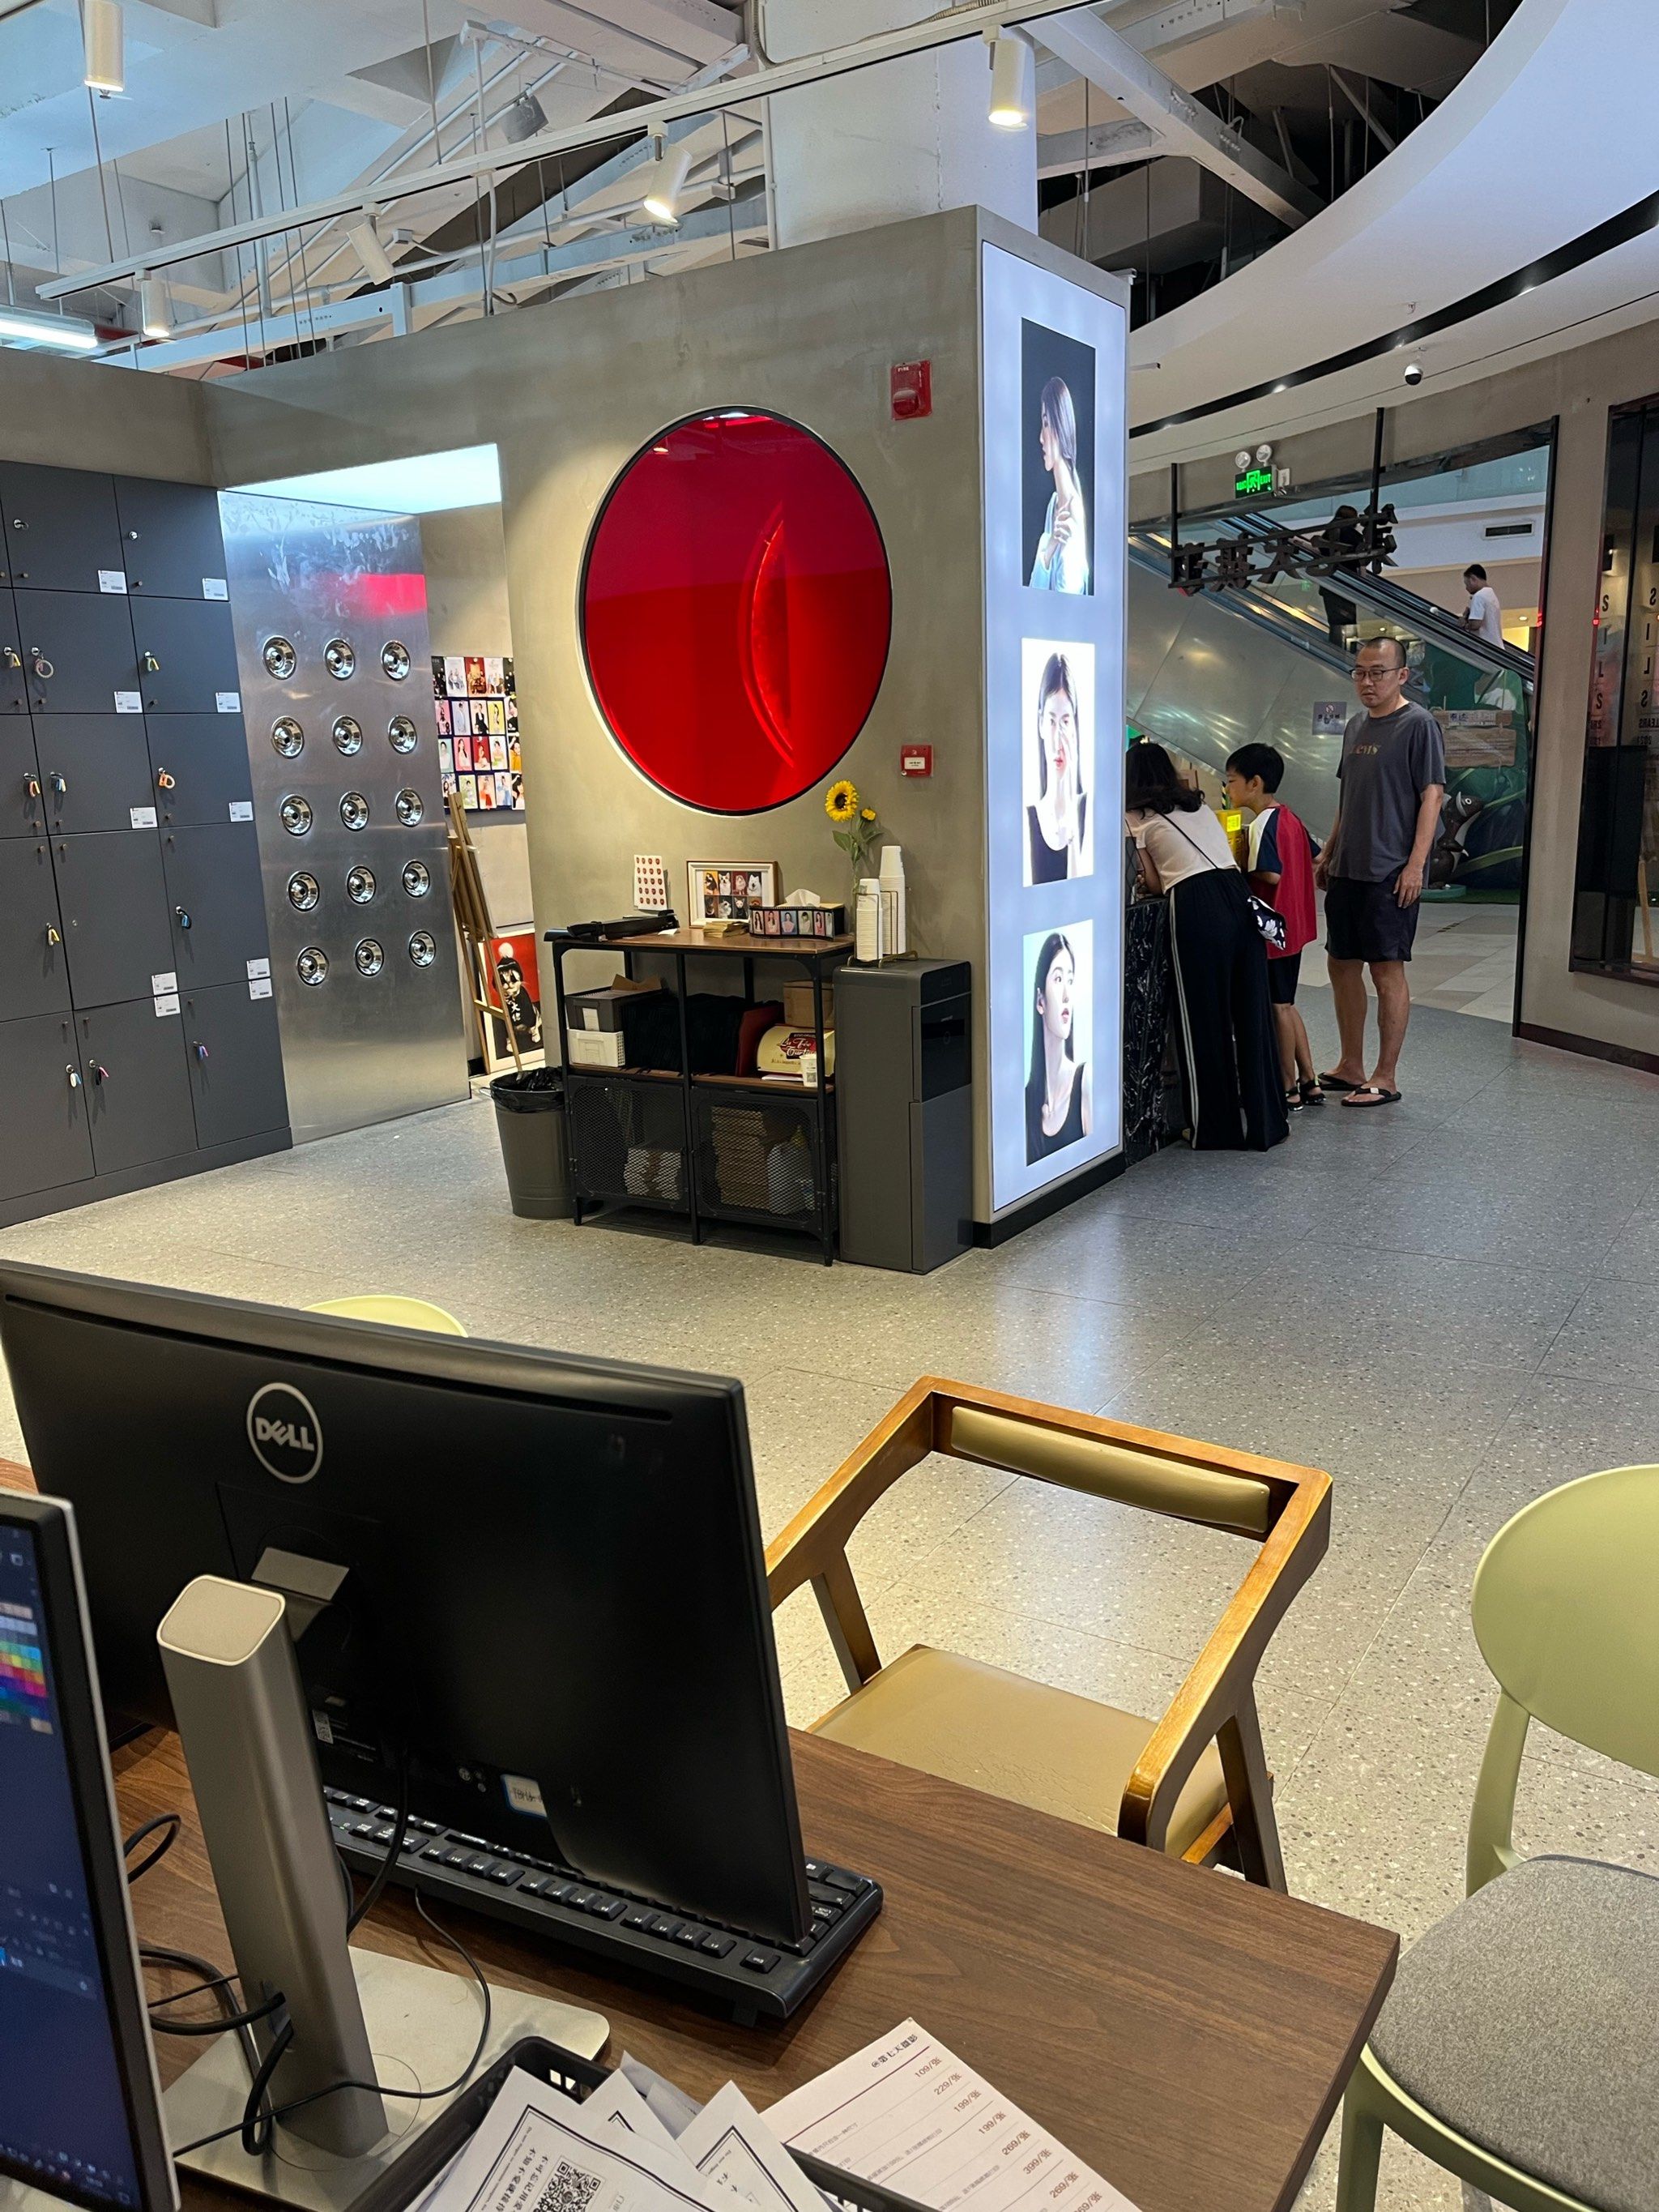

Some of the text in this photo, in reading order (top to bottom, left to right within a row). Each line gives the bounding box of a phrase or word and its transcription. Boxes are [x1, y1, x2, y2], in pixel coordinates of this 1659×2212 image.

[255, 1417, 314, 1451] DELL
[915, 2056, 942, 2077] 109/张
[934, 2072, 962, 2095] 229/张
[953, 2090, 982, 2113] 199/张
[979, 2111, 1006, 2134] 199/张
[1001, 2130, 1031, 2156] 269/张
[1022, 2148, 1052, 2175] 399/张
[1049, 2171, 1079, 2199] 269/张
[1074, 2192, 1102, 2212] 69/张
